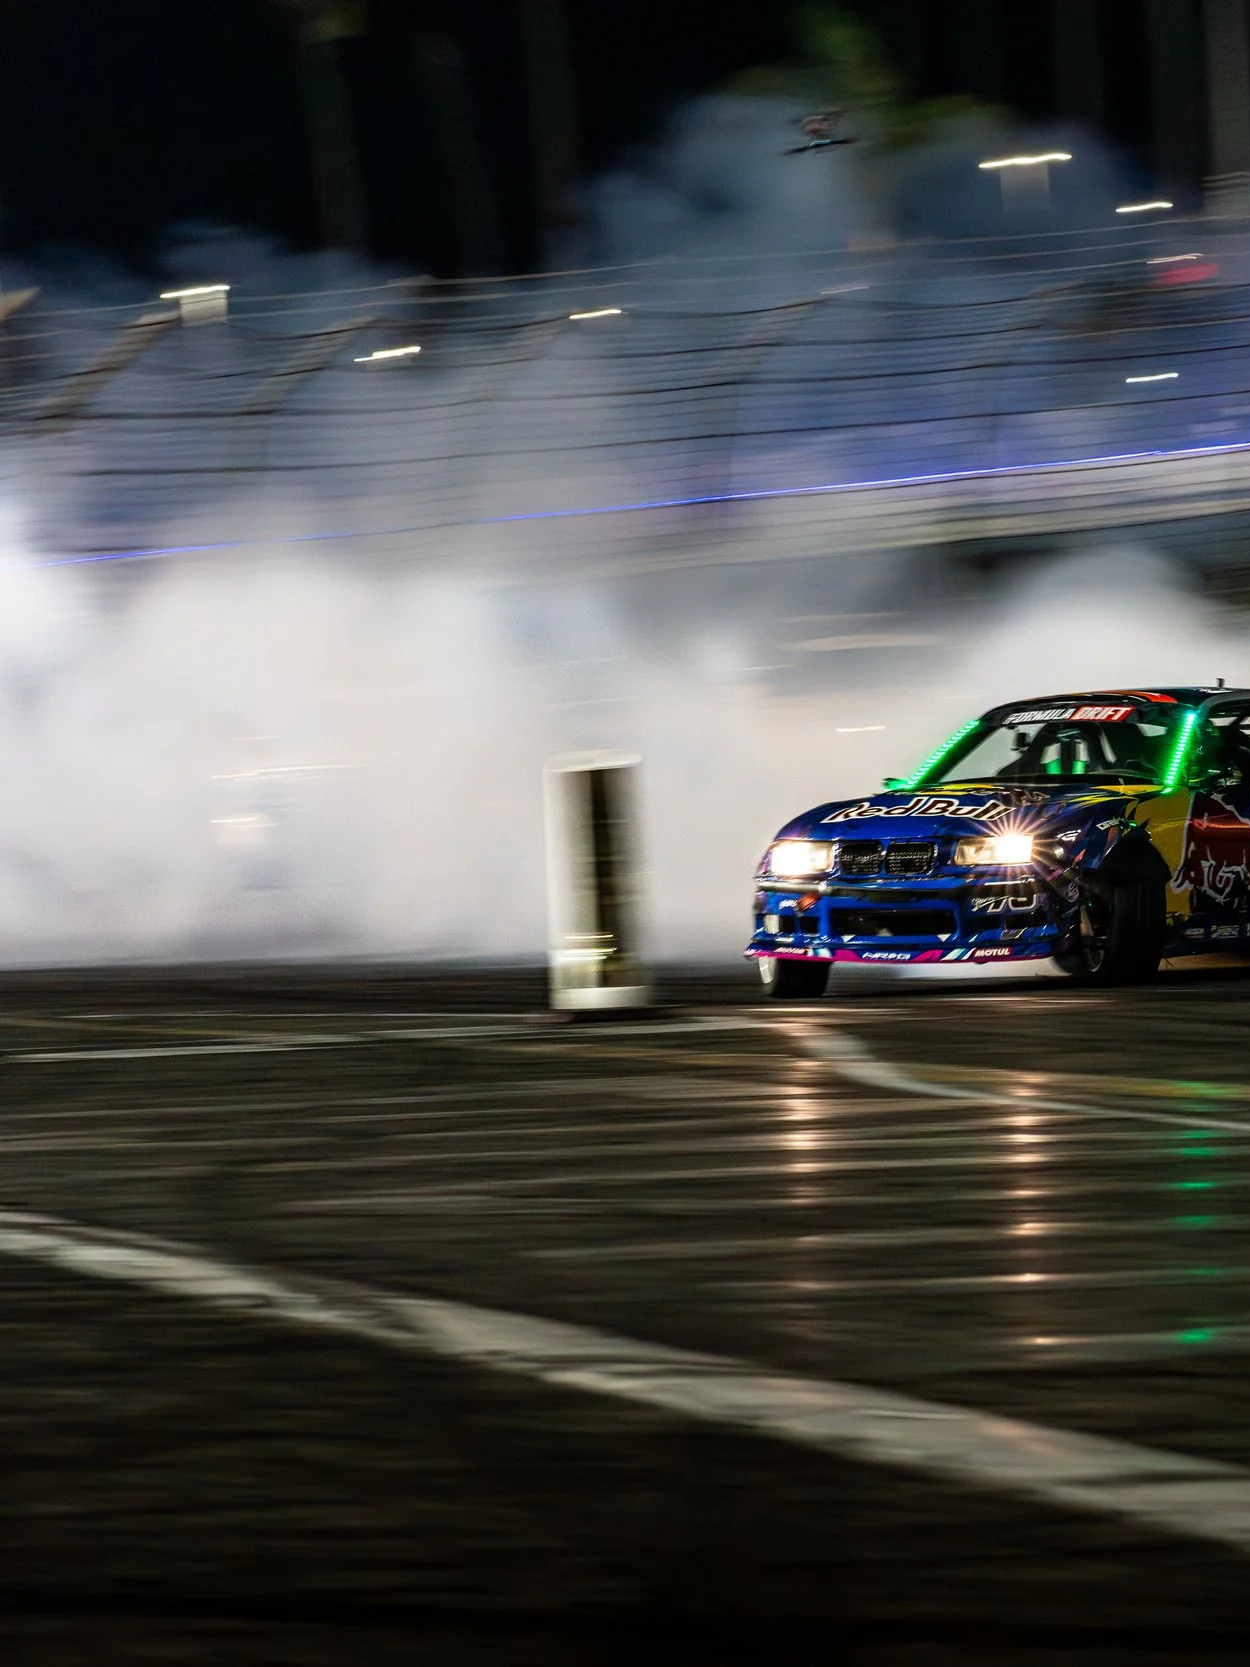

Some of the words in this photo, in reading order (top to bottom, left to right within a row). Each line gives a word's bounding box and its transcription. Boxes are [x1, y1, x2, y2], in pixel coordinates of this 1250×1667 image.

[1002, 708, 1077, 725] FORMULA
[1072, 706, 1133, 721] DRIFT
[974, 947, 1010, 957] MOTUL
